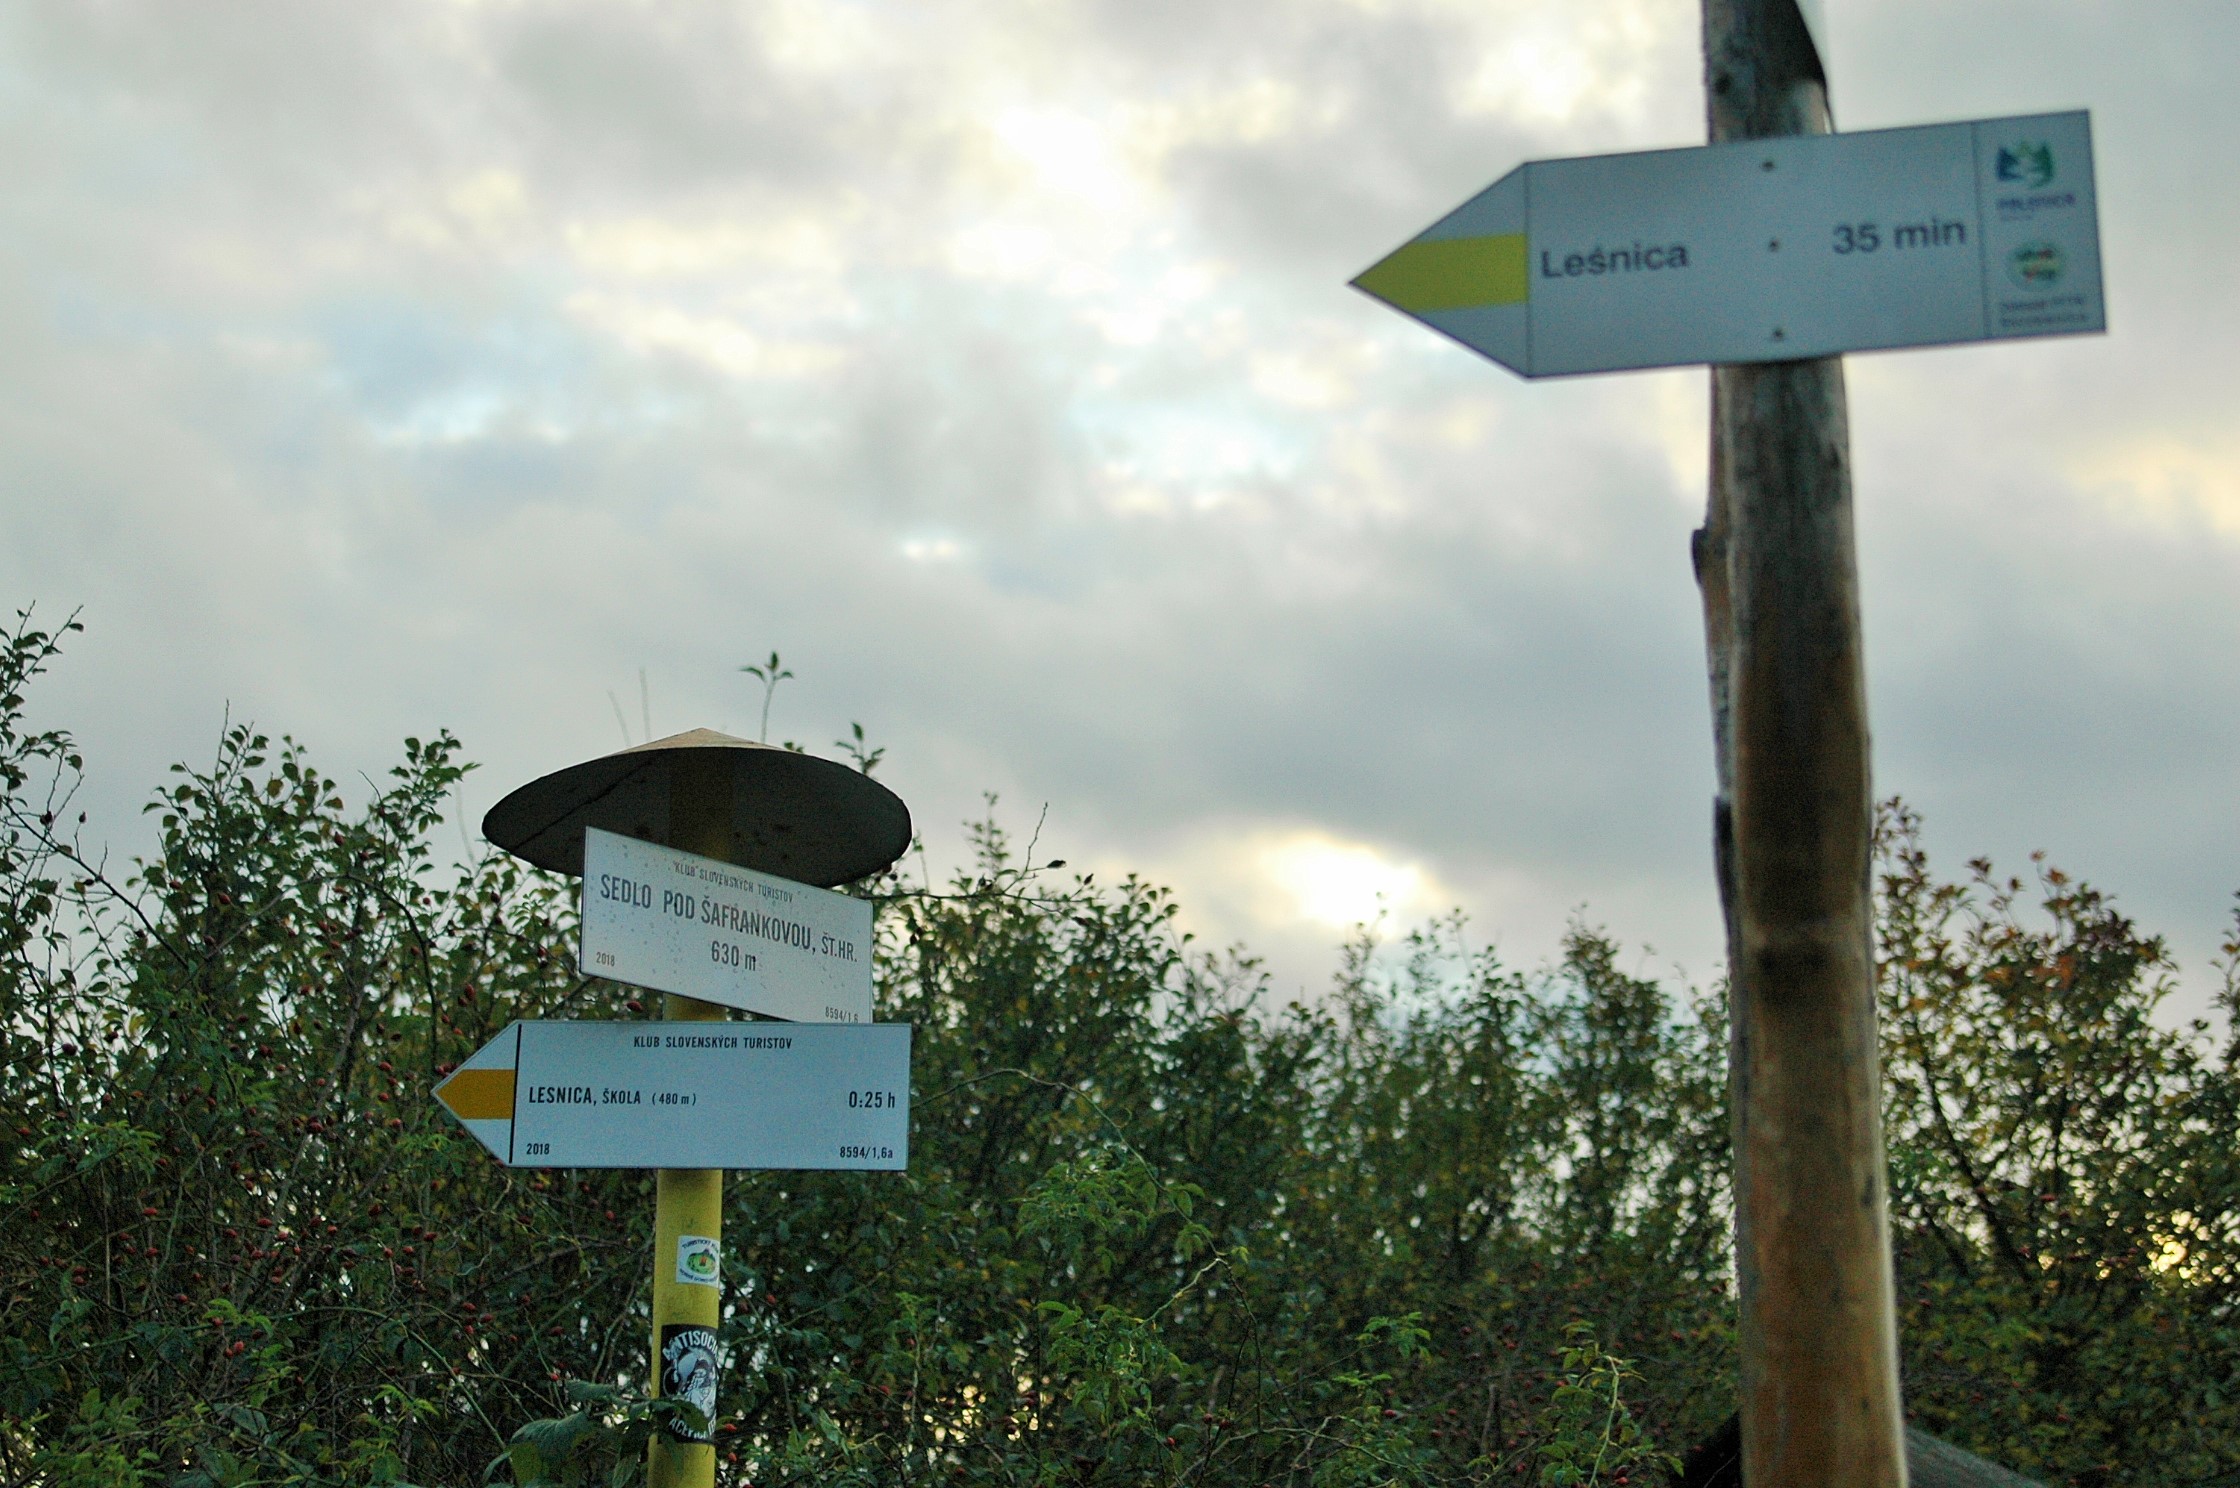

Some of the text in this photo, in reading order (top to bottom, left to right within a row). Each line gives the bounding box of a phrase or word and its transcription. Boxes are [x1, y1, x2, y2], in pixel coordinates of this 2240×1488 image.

[1832, 215, 1968, 255] 35 min
[1541, 240, 1689, 279] Leśnica
[675, 861, 696, 878] KLUB
[757, 883, 794, 903] TURISTOV
[600, 873, 858, 962] SEDLO POD ŠAFRANKOVOU, ŠT.HR.
[596, 951, 615, 967] 2018
[711, 940, 756, 972] 630 m
[633, 1034, 793, 1050] KLUB SLOVENSKÝCH TURISTOV
[528, 1086, 597, 1107] LESNICA,
[602, 1088, 642, 1105] ŠKOLA
[848, 1090, 896, 1109] 0:25 h
[526, 1142, 550, 1156] 2018
[840, 1145, 893, 1160] 8594/1,6a
